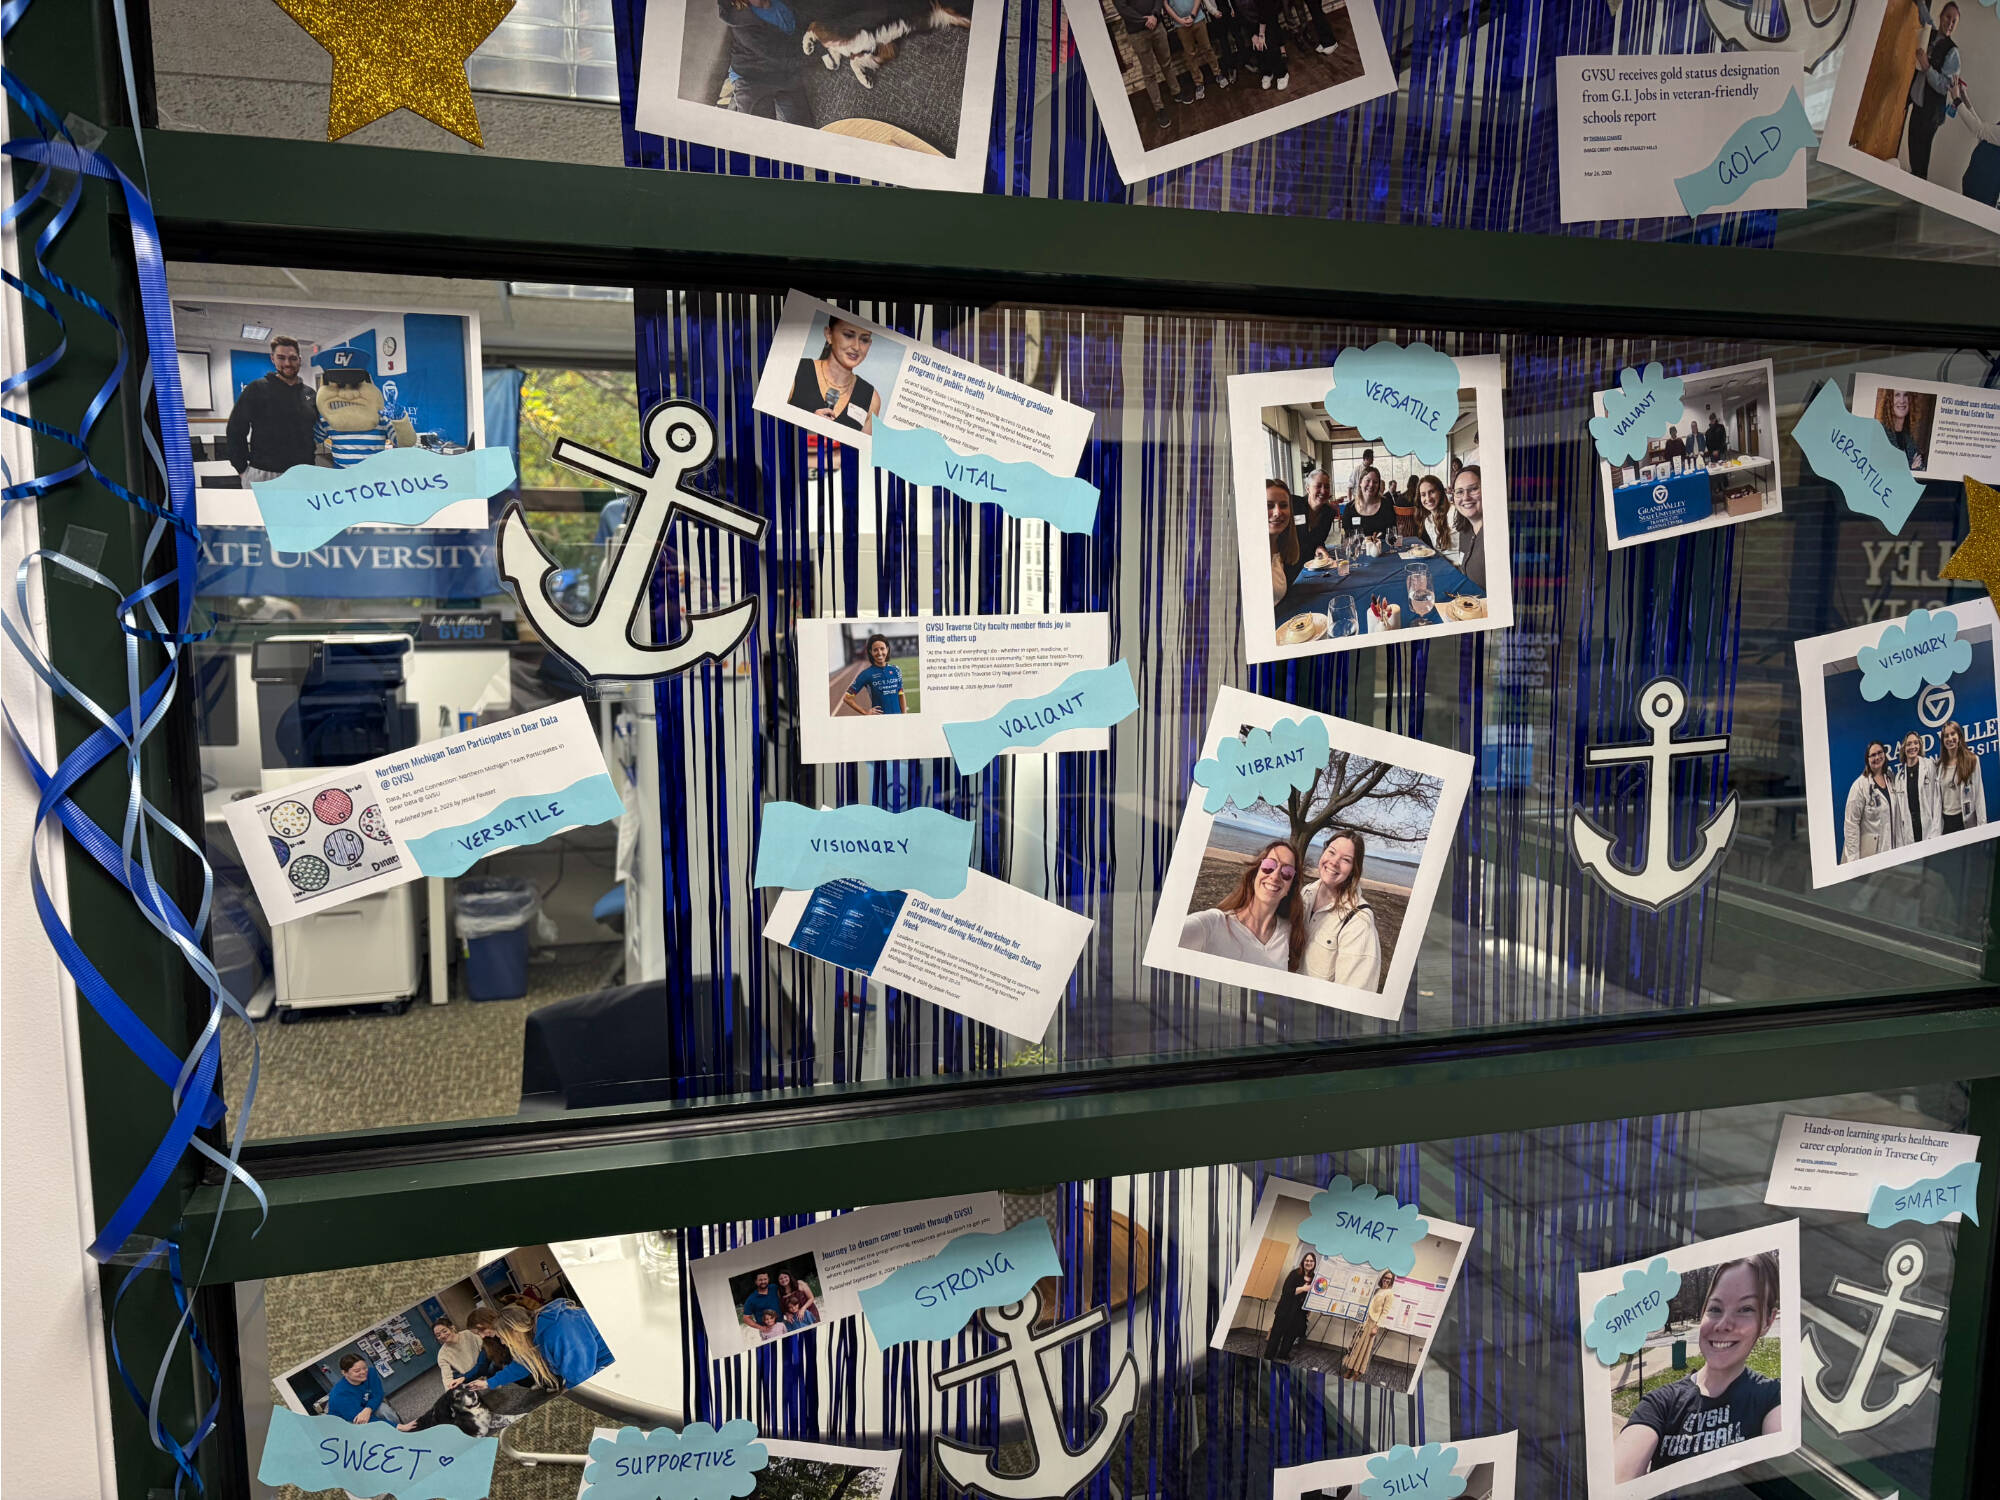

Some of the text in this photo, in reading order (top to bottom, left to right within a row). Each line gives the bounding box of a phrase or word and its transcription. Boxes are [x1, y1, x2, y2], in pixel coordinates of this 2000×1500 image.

[1581, 64, 1779, 83] GVSU receives gold status designation
[1582, 83, 1758, 103] from G.I. Jobs in veteran-friendly
[1583, 110, 1656, 126] schools report
[1719, 127, 1781, 184] GOLD
[908, 364, 984, 400] program in public health
[912, 351, 1053, 415] GVSU meets area needs by launching graduate
[1367, 380, 1440, 431] VERSATILE
[1614, 390, 1657, 436] VALIANT
[945, 461, 1007, 492] VITAL
[271, 546, 486, 569] UNIVERSITY
[430, 616, 446, 628] Life
[440, 624, 486, 639] GVSU
[925, 623, 944, 631] GVSU
[946, 622, 971, 631] Traverse
[973, 622, 985, 631] City
[987, 622, 1008, 630] faculty
[1010, 621, 1035, 629] member
[1054, 621, 1063, 629] joy
[926, 634, 945, 644] lifting
[375, 762, 410, 777] Northern
[410, 751, 445, 766] Michigan
[445, 744, 466, 755] Team
[466, 731, 511, 749] Participates
[520, 722, 538, 733] Dear
[539, 716, 558, 726] Data
[424, 777, 458, 790] Connection:
[458, 769, 484, 779] Northern
[484, 761, 509, 771] Michigan
[526, 746, 558, 758] Participates
[1236, 748, 1304, 776] VIBRANT
[380, 772, 413, 790] @ GVSU
[424, 791, 440, 800] GVSU
[902, 919, 918, 931] Week
[911, 898, 1020, 949] GVSU will host applied AI workshop for
[906, 910, 1041, 970] entrepreneurs during Northern Michigan Startup
[1803, 1122, 1948, 1147] Hands-on learning sparks healthcare
[1799, 1142, 1938, 1165] career exploration in Traverse City
[1895, 1184, 1962, 1211] SMART
[822, 1247, 847, 1260] Journey
[857, 1237, 879, 1248] dream
[880, 1229, 901, 1241] career
[903, 1222, 926, 1234] travels
[927, 1213, 953, 1227] through
[954, 1206, 972, 1219] GVSU
[1336, 1206, 1402, 1242] SMART
[914, 1252, 1014, 1307] STRONG
[1606, 1289, 1661, 1334] SPIRITED
[1683, 1405, 1730, 1432] GVSU
[1660, 1422, 1744, 1456] FOOTBALL
[320, 1438, 431, 1480] SWEET
[616, 1449, 735, 1476] SUPPORTIVE
[1383, 1468, 1428, 1496] SILLY
